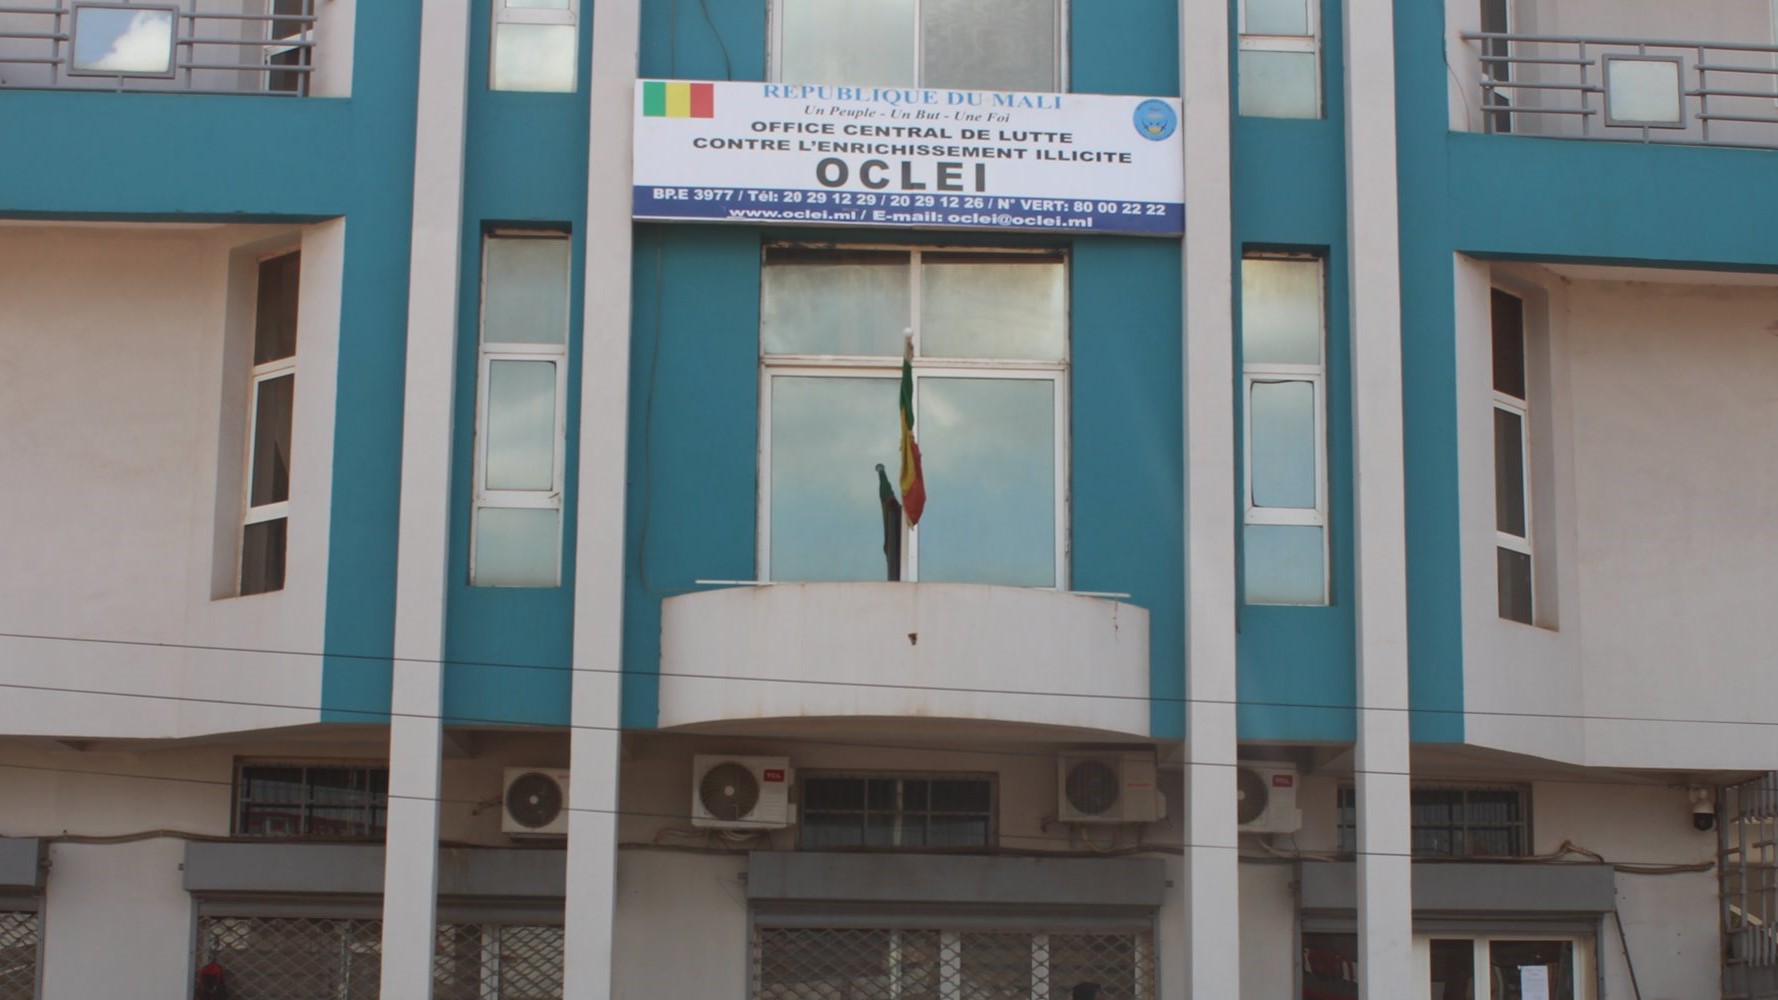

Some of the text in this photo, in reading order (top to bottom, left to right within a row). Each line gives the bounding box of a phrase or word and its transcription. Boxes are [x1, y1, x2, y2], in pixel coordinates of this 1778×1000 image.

[764, 85, 1062, 109] REPUBLIQUE DU MALI
[804, 105, 824, 115] Un
[830, 106, 876, 119] Peuple
[891, 109, 910, 119] Un
[915, 110, 939, 120] But
[954, 111, 981, 122] Une
[987, 112, 1010, 123] Foi
[751, 121, 1073, 143] OFFICE CENTRAL DE LUTTE
[693, 137, 1132, 163] CONTRE L’ENRICHISSEMENT ILLICITE
[816, 157, 986, 192] OCLEI
[694, 189, 733, 201] 3977
[738, 189, 743, 201] /
[748, 190, 778, 202] Tél:
[783, 191, 802, 203] 20
[807, 192, 826, 204] 29
[832, 193, 851, 204] 12
[856, 194, 876, 206] 29
[880, 195, 886, 206] /
[890, 195, 910, 207] 20
[915, 196, 934, 207] 29
[940, 196, 959, 208] 12
[964, 197, 984, 209] 26
[988, 198, 993, 209] /
[1021, 199, 1068, 211] VERT:
[1073, 201, 1093, 213] 80
[1097, 202, 1117, 214] 00
[1122, 203, 1142, 215] 22
[1146, 204, 1166, 216] 22
[729, 208, 1093, 227] www.oclei.ml / E-mail: oclei@oclei.ml
